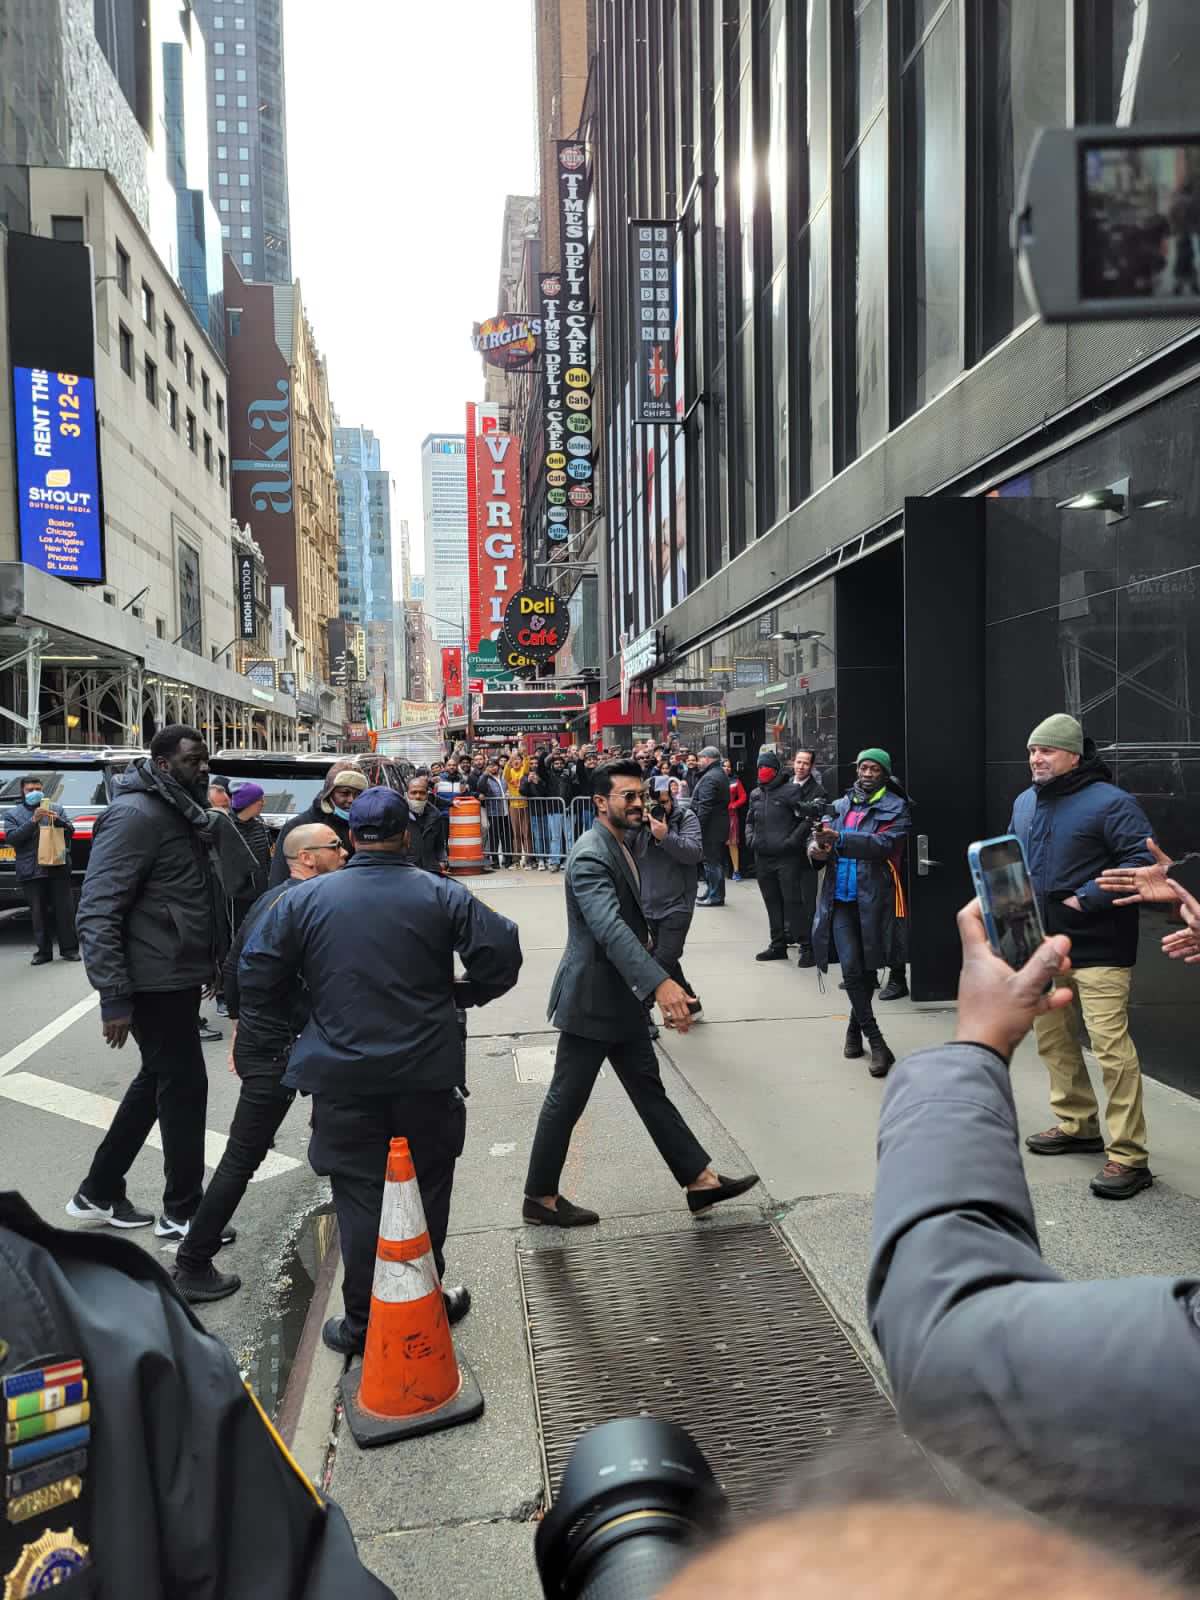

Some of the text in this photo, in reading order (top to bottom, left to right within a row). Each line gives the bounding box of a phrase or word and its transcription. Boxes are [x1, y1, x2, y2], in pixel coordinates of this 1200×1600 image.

[561, 174, 585, 239] TIMES
[565, 242, 586, 295] DELI
[568, 299, 585, 312] &
[542, 300, 561, 351] TIMES
[470, 319, 542, 352] VIRGIL'S
[565, 315, 588, 365] CAFE
[545, 354, 562, 395] DELI
[568, 372, 587, 383] Deli
[58, 372, 81, 437] 312-6
[547, 399, 561, 408] &
[568, 395, 589, 405] Cafe
[32, 406, 51, 457] RENT
[546, 411, 565, 451] CAFE
[548, 457, 564, 465] Deli
[29, 487, 91, 505] SHOUT
[67, 505, 91, 513] MEDIA
[48, 518, 74, 528] Boston
[39, 535, 85, 546] Los Angeles
[46, 527, 77, 538] Chicago
[45, 544, 80, 554] New York
[242, 560, 253, 634] A DOLL'S HOUSE
[520, 597, 555, 614] Deli
[530, 615, 546, 630] &
[518, 627, 558, 646] Café
[478, 725, 542, 733] O'DONOGHUE'S
